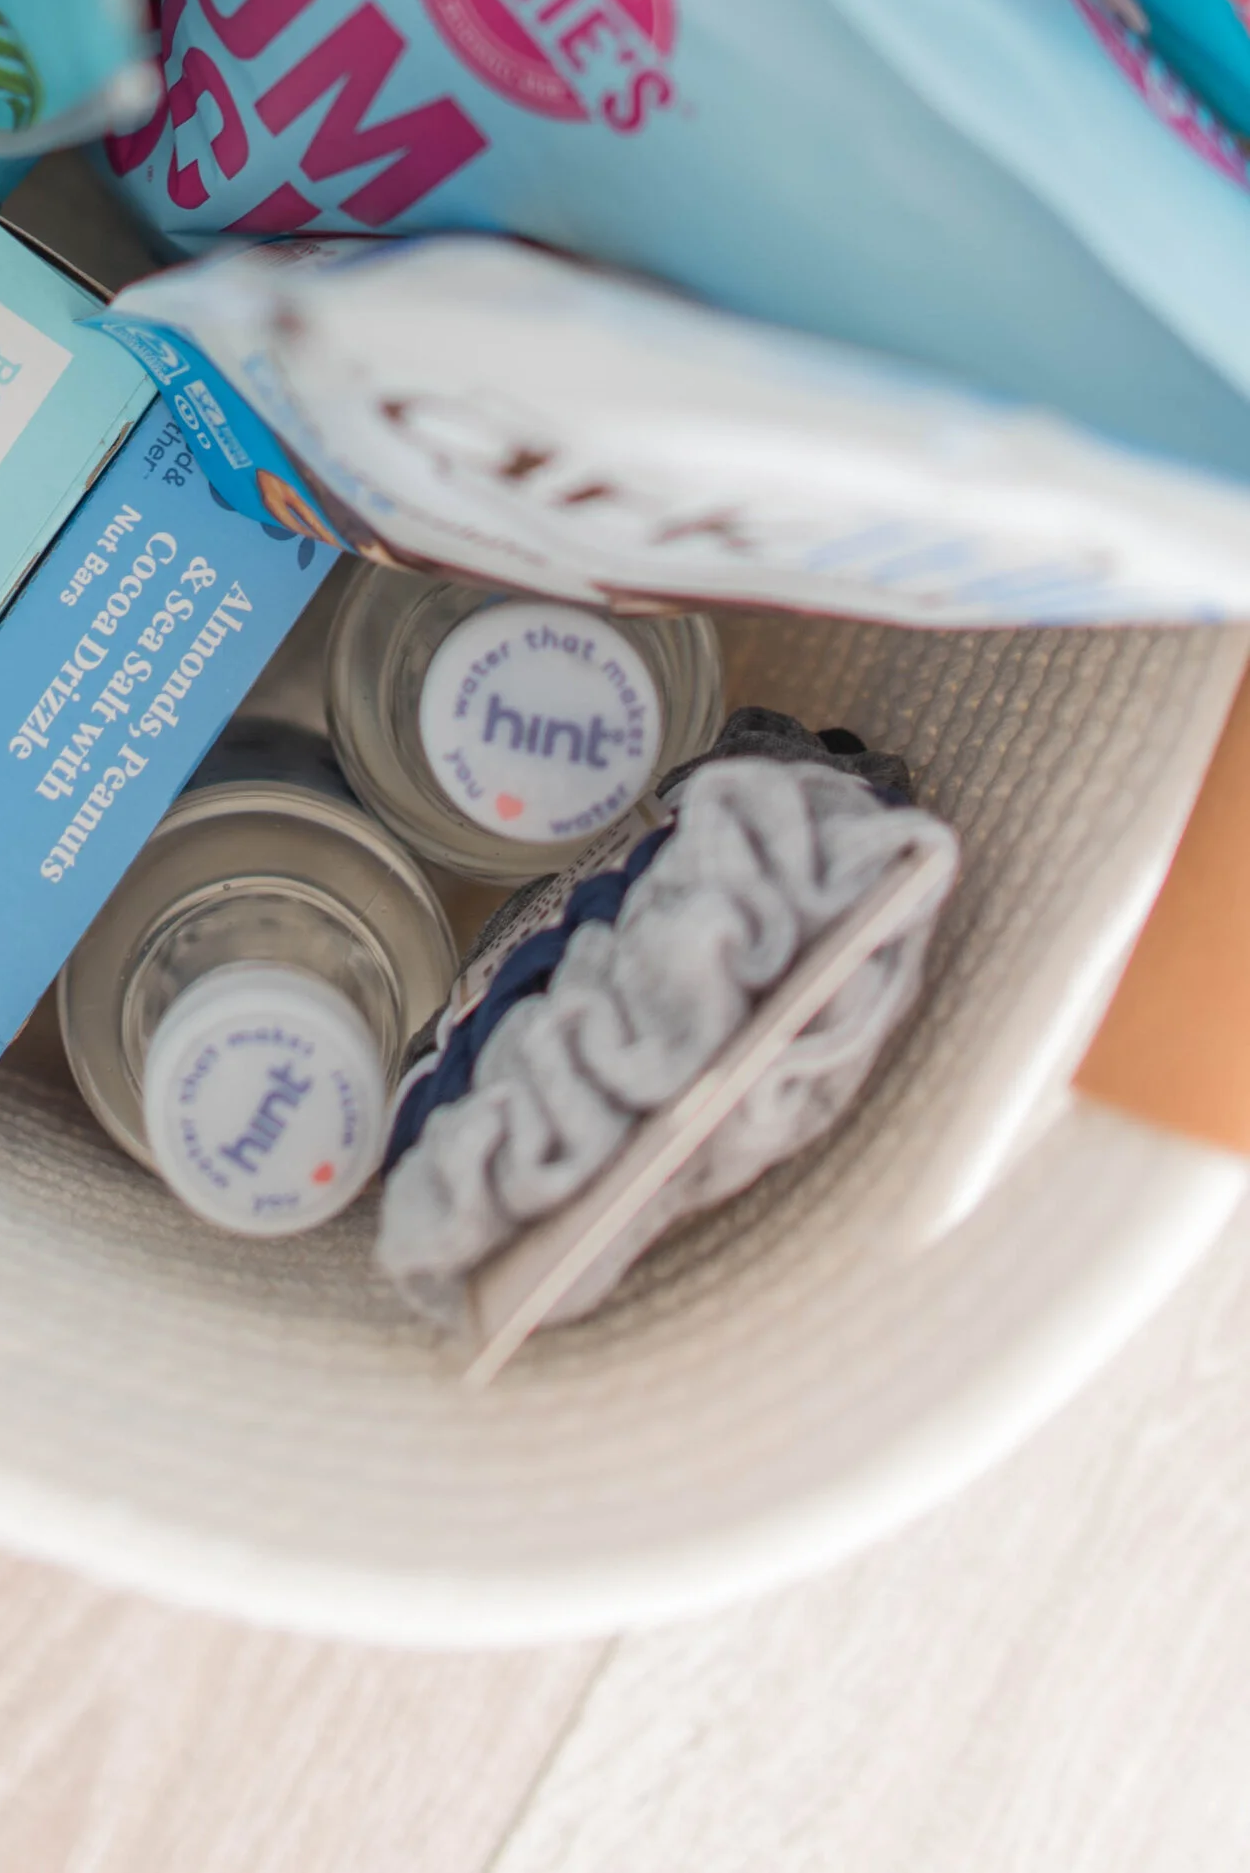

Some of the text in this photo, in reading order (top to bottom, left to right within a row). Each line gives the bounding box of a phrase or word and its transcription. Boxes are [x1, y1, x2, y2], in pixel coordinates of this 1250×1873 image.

[60, 504, 143, 607] Nut Bars
[8, 531, 177, 760] Cocoa Drizzle
[35, 556, 217, 801] & Sea Salt with
[129, 581, 253, 739] Almonds,
[523, 624, 595, 661] that
[443, 747, 484, 799] you
[482, 692, 609, 770] hint
[40, 743, 149, 883] Peanuts
[218, 1060, 314, 1174] hint
